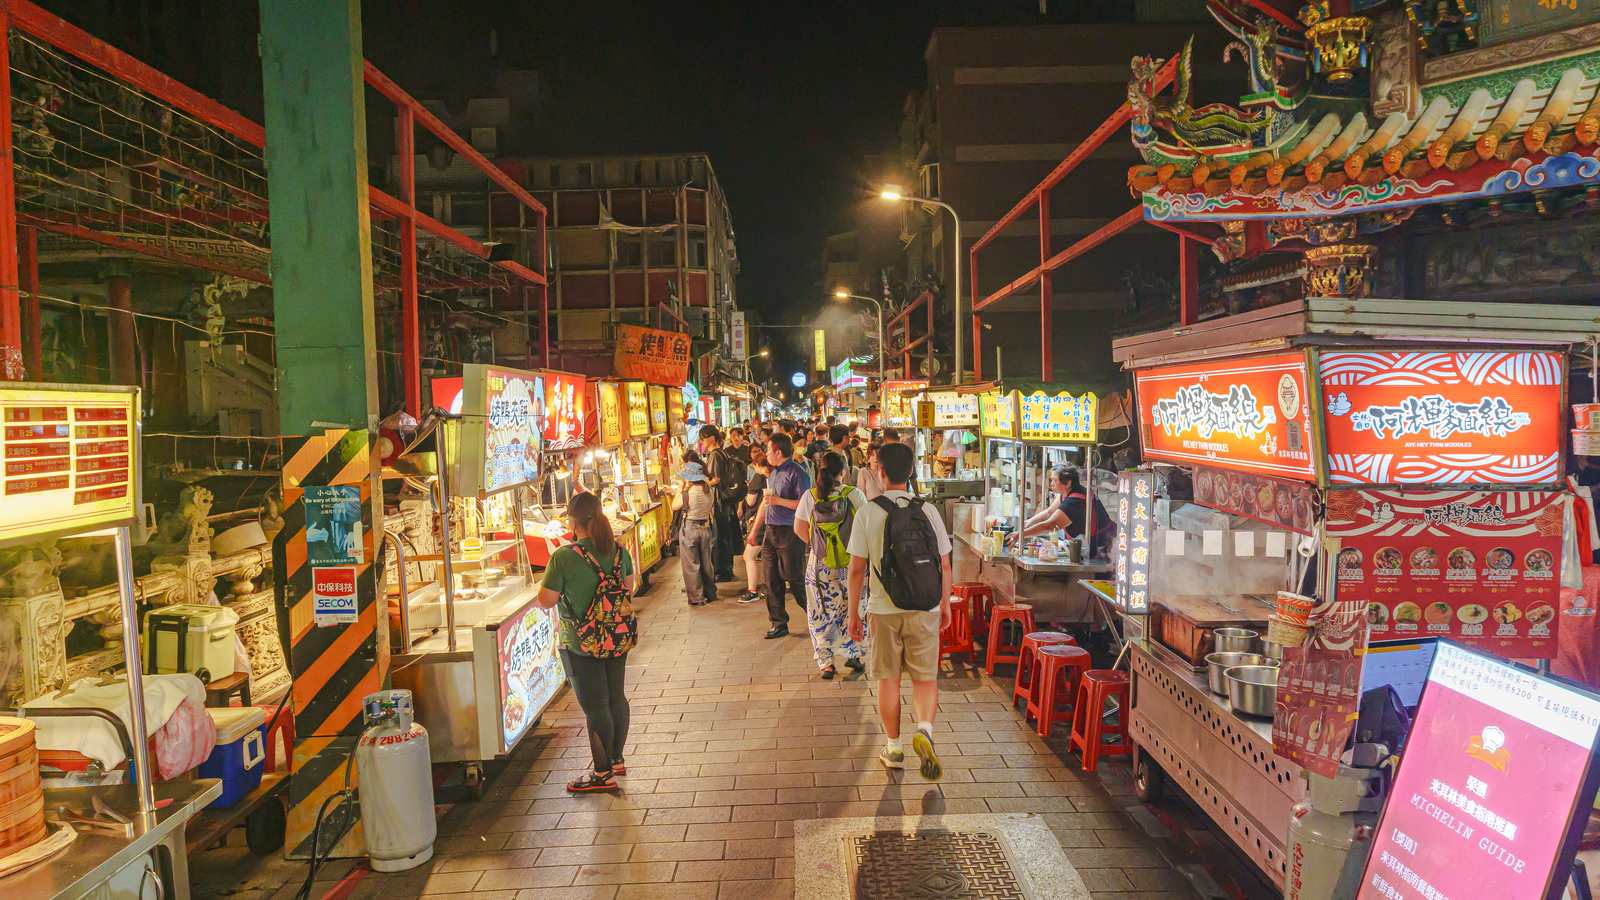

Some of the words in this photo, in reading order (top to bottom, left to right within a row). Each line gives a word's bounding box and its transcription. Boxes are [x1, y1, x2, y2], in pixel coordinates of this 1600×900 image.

[317, 582, 353, 592] 中保科技
[318, 599, 353, 607] SECOM
[1410, 793, 1475, 841] MICHELIN
[1479, 837, 1526, 873] GUIDE
